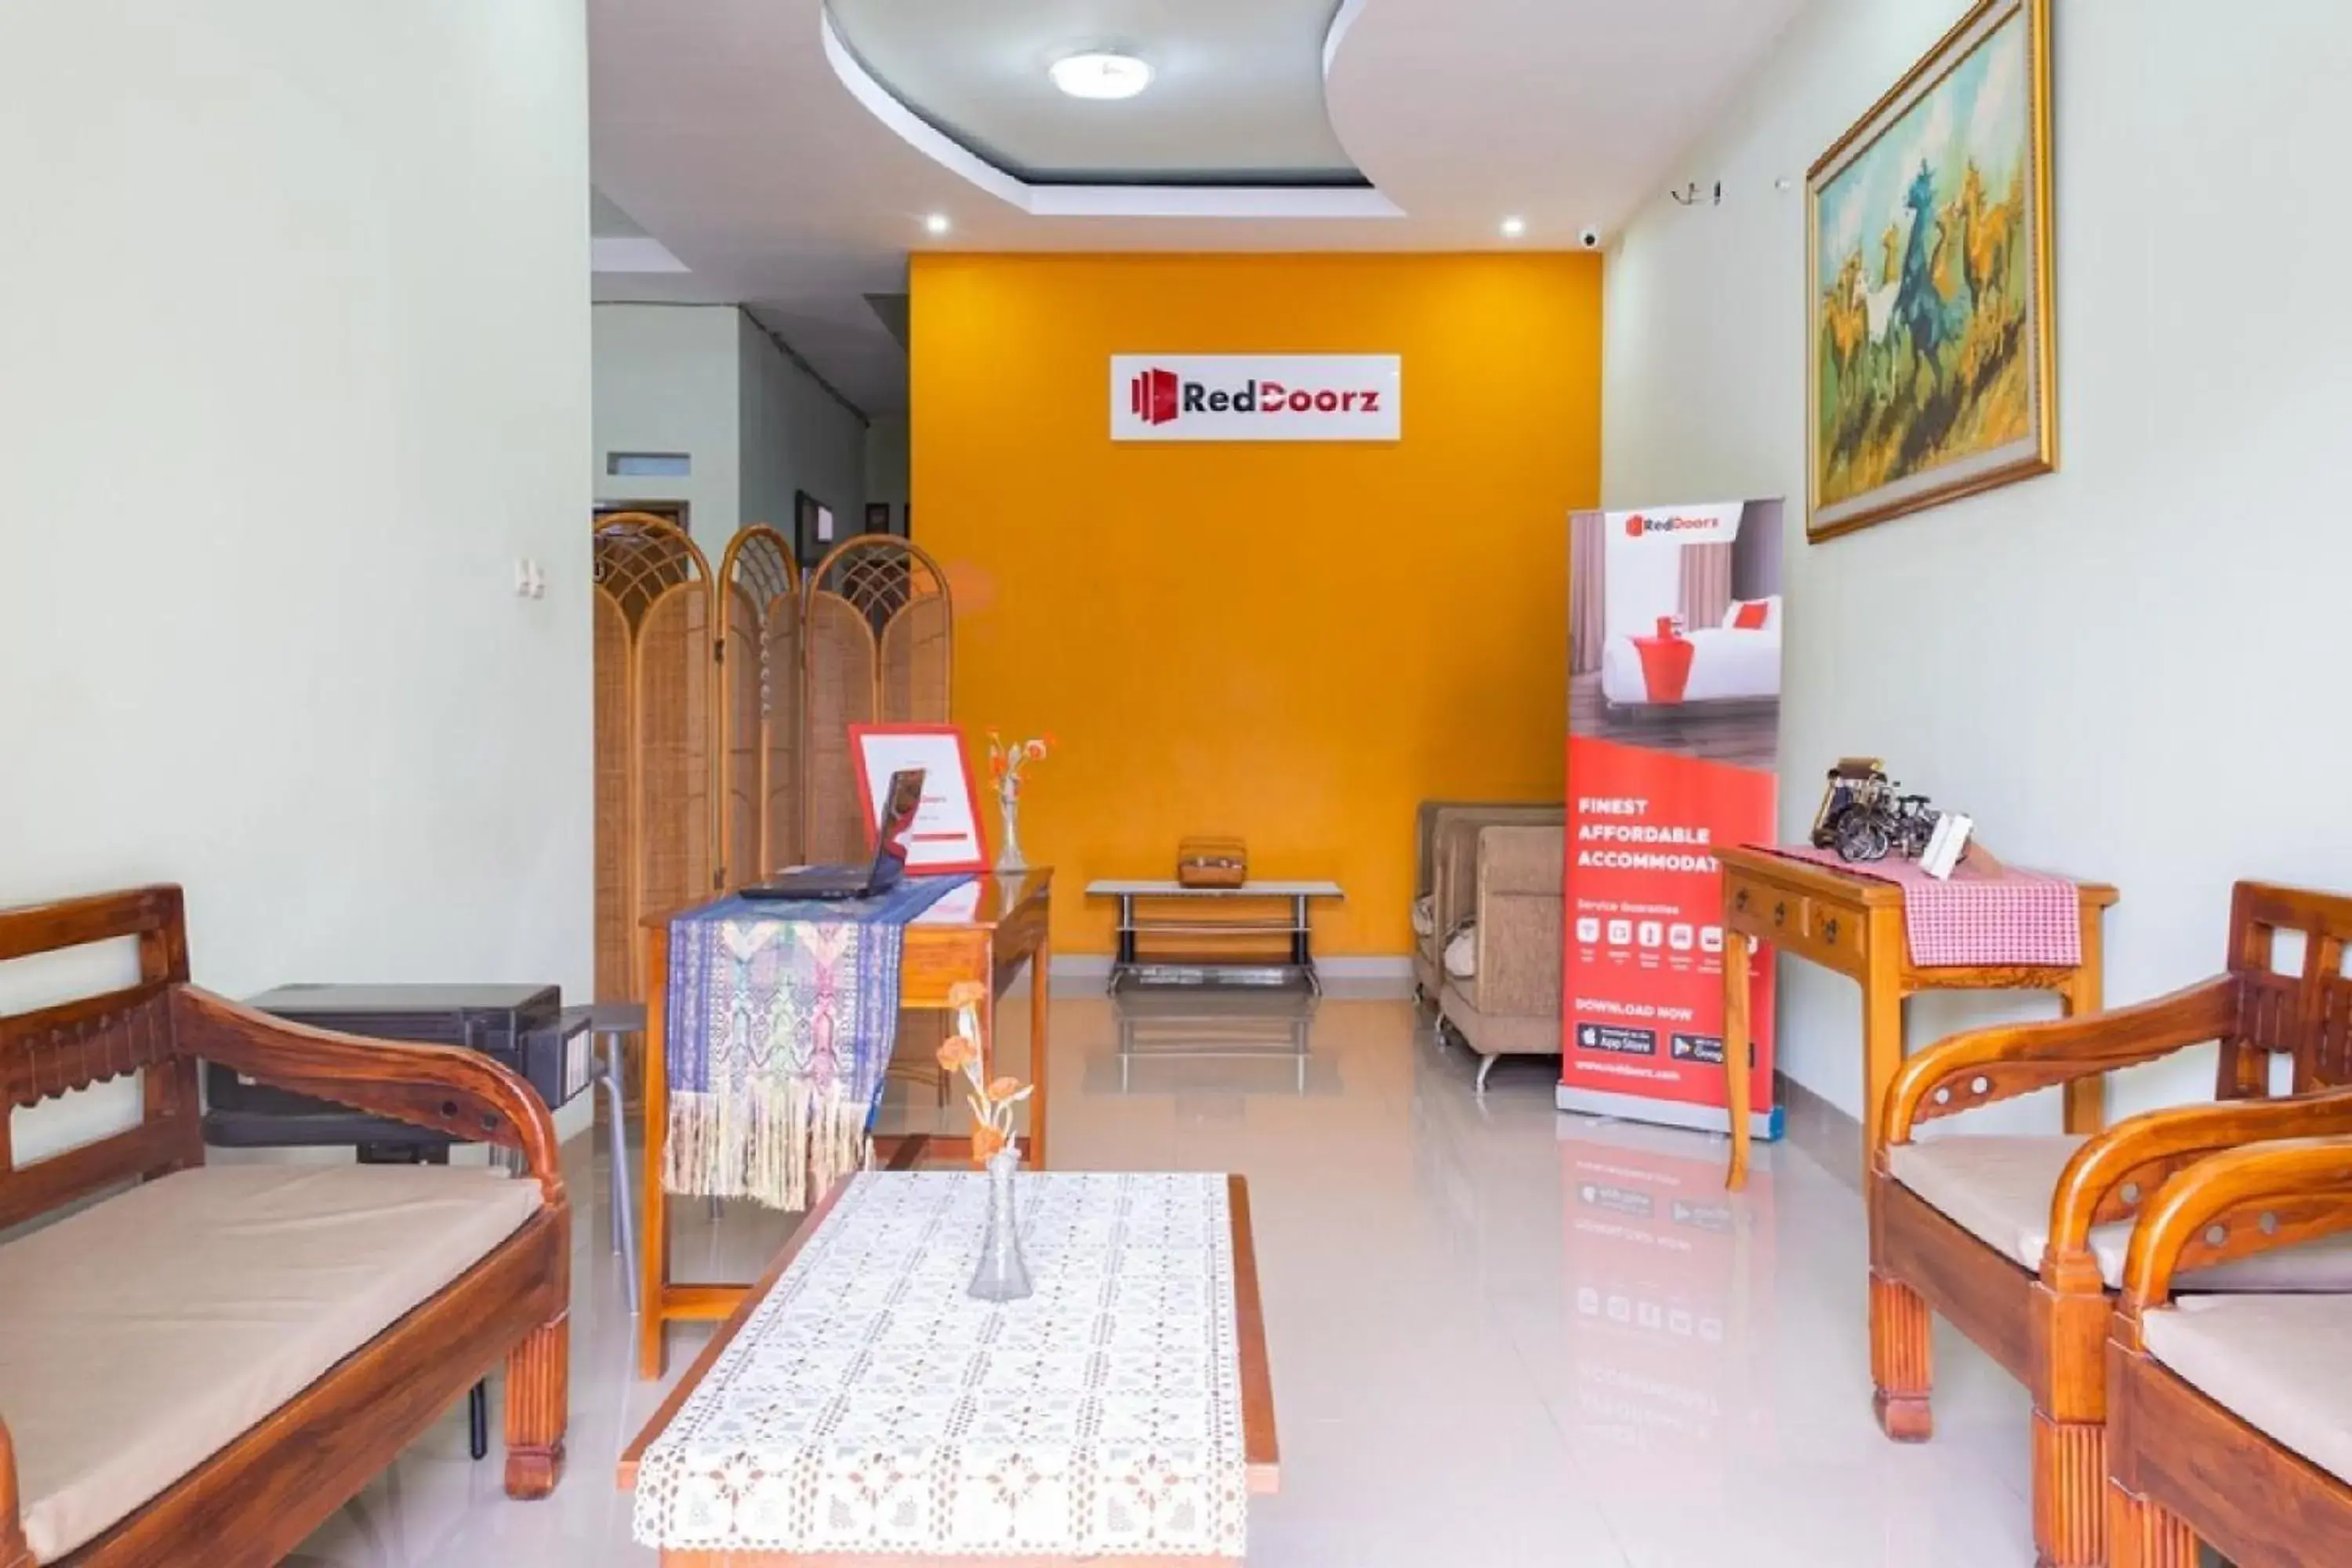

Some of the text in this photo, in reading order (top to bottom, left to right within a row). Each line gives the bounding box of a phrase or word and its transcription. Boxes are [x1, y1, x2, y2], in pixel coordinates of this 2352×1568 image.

[1183, 379, 1380, 412] RedDoorz
[1578, 798, 1648, 815] FINEST
[1578, 826, 1710, 844] AFFORDABLE
[1576, 998, 1693, 1021] DOWNLOAD NOW
